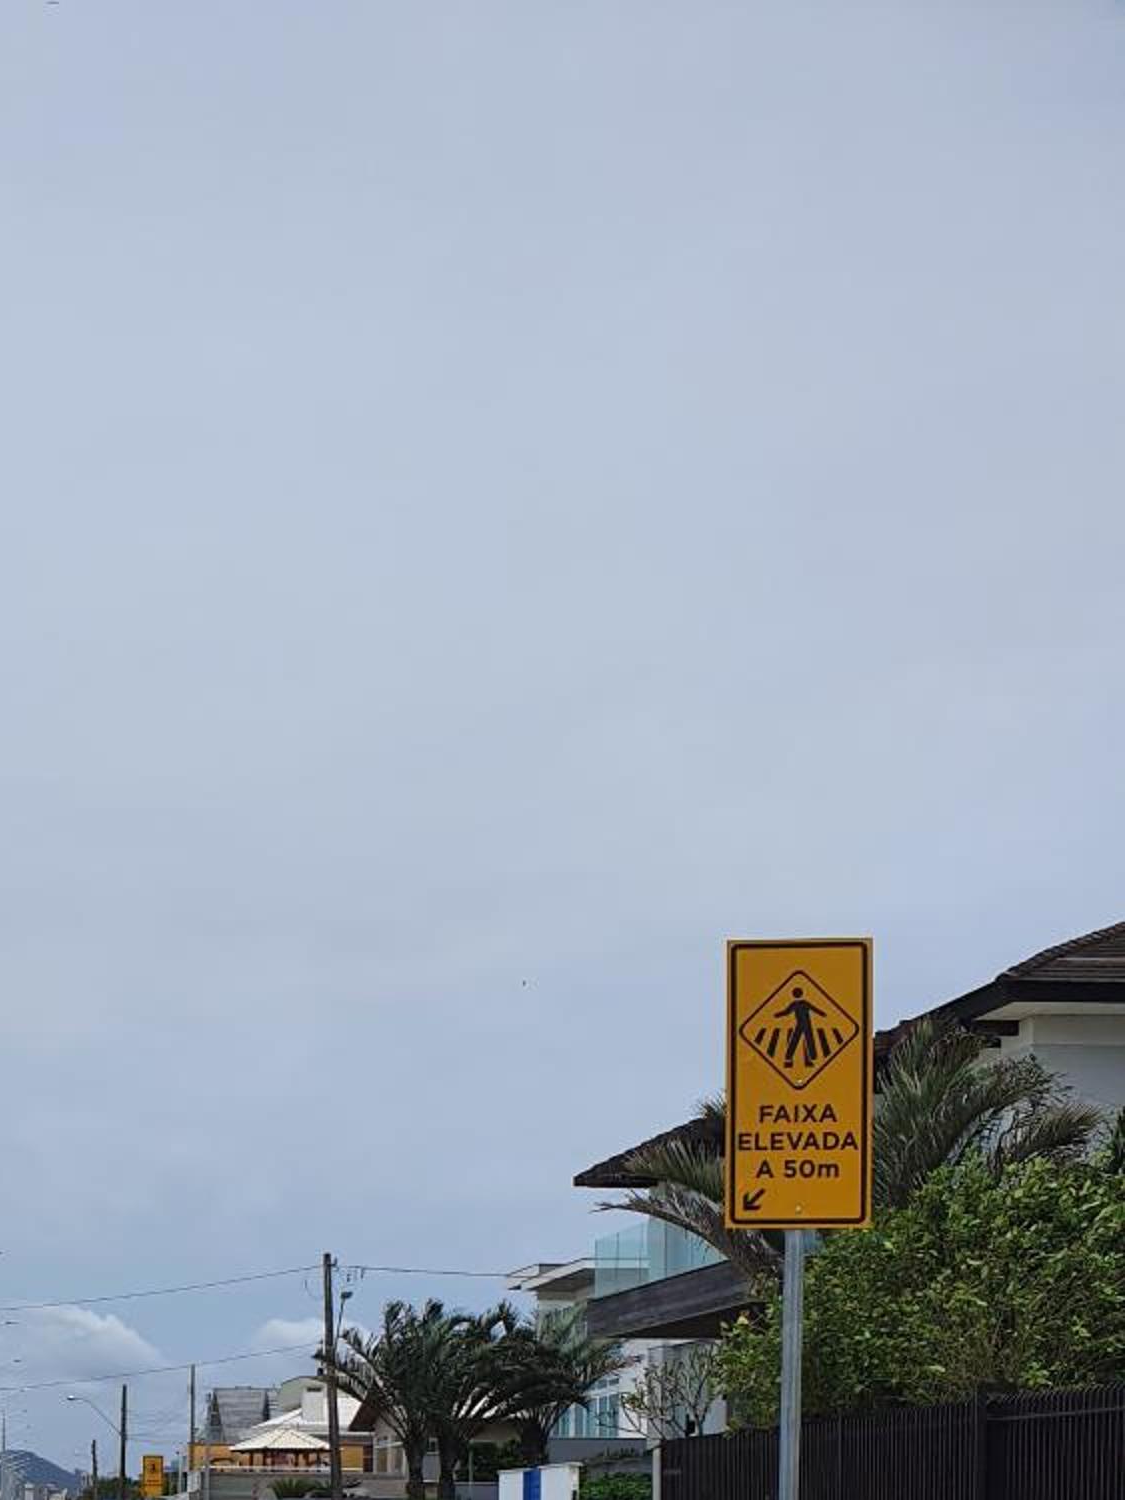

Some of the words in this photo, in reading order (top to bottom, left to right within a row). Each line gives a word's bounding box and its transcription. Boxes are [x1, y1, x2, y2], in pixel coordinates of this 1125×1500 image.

[759, 1104, 837, 1123] FAIXA
[738, 1132, 858, 1150] ELEVADA
[756, 1160, 774, 1178] A
[784, 1160, 840, 1178] 50m
